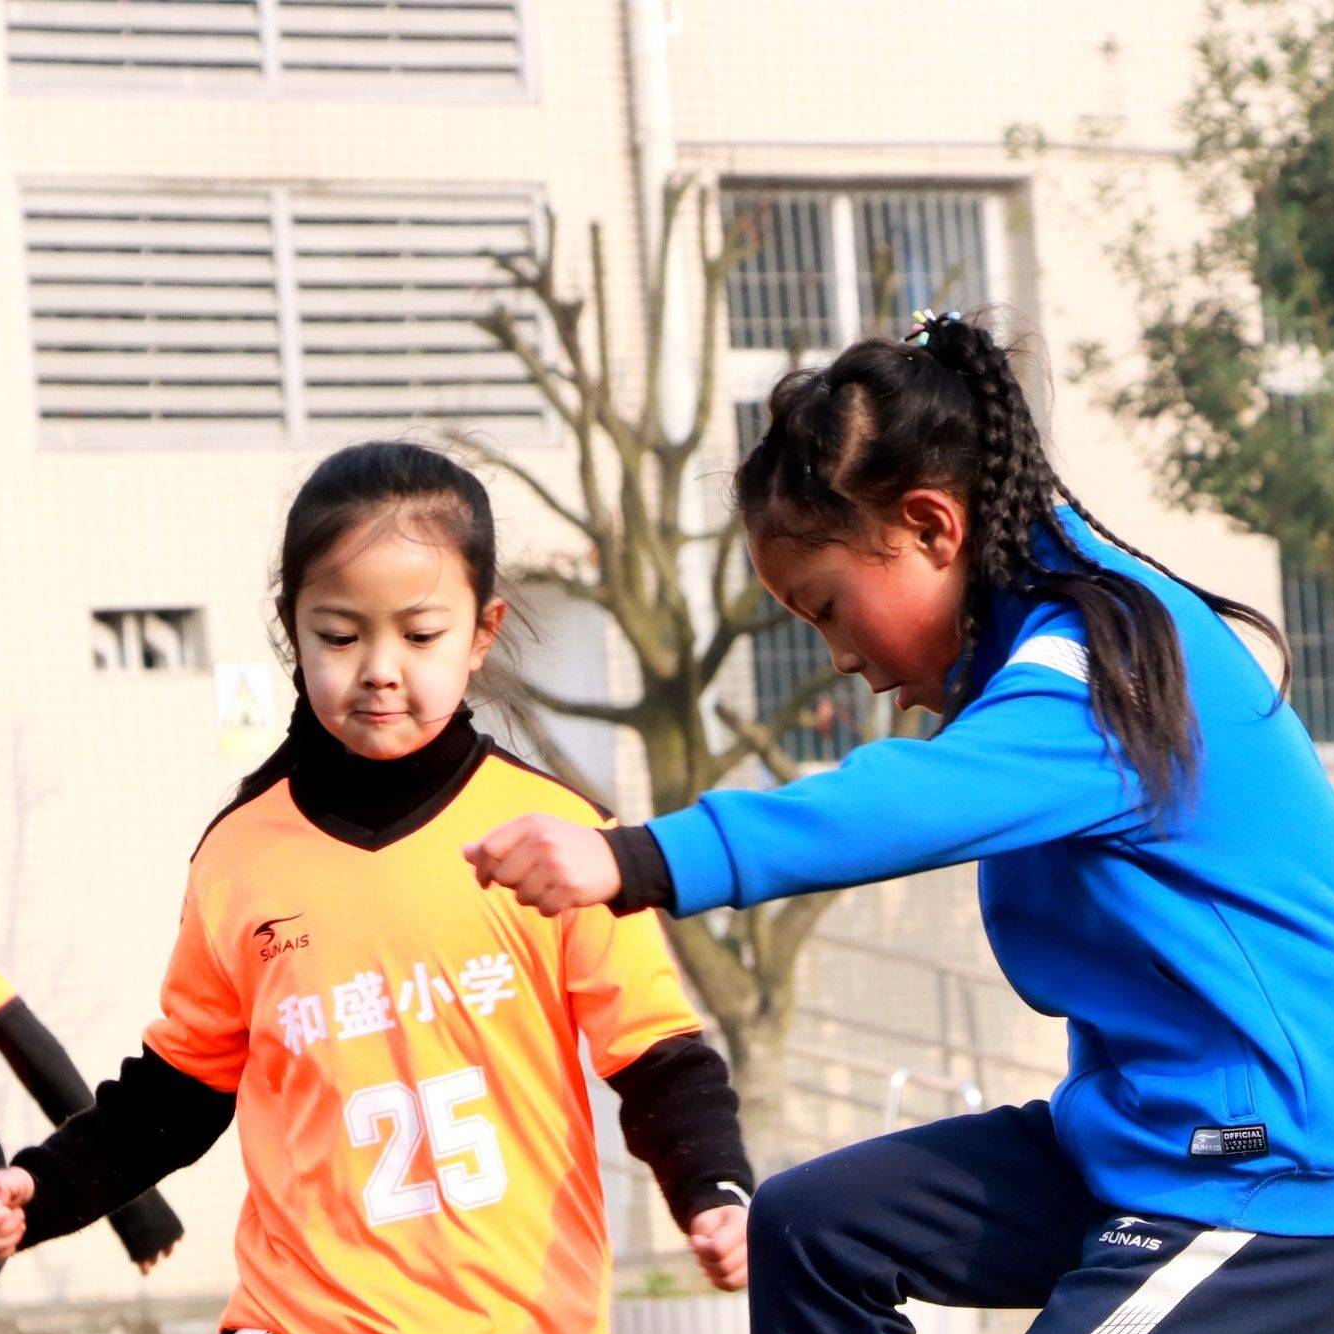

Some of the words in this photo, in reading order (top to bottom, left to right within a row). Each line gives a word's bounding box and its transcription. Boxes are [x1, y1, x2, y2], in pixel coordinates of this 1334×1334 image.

[260, 934, 310, 962] SUNAIS
[278, 953, 517, 1055] 和盛小学
[345, 1067, 507, 1227] 25
[1223, 1130, 1262, 1141] OFFICIAL
[1098, 1231, 1164, 1251] SUNAIS
